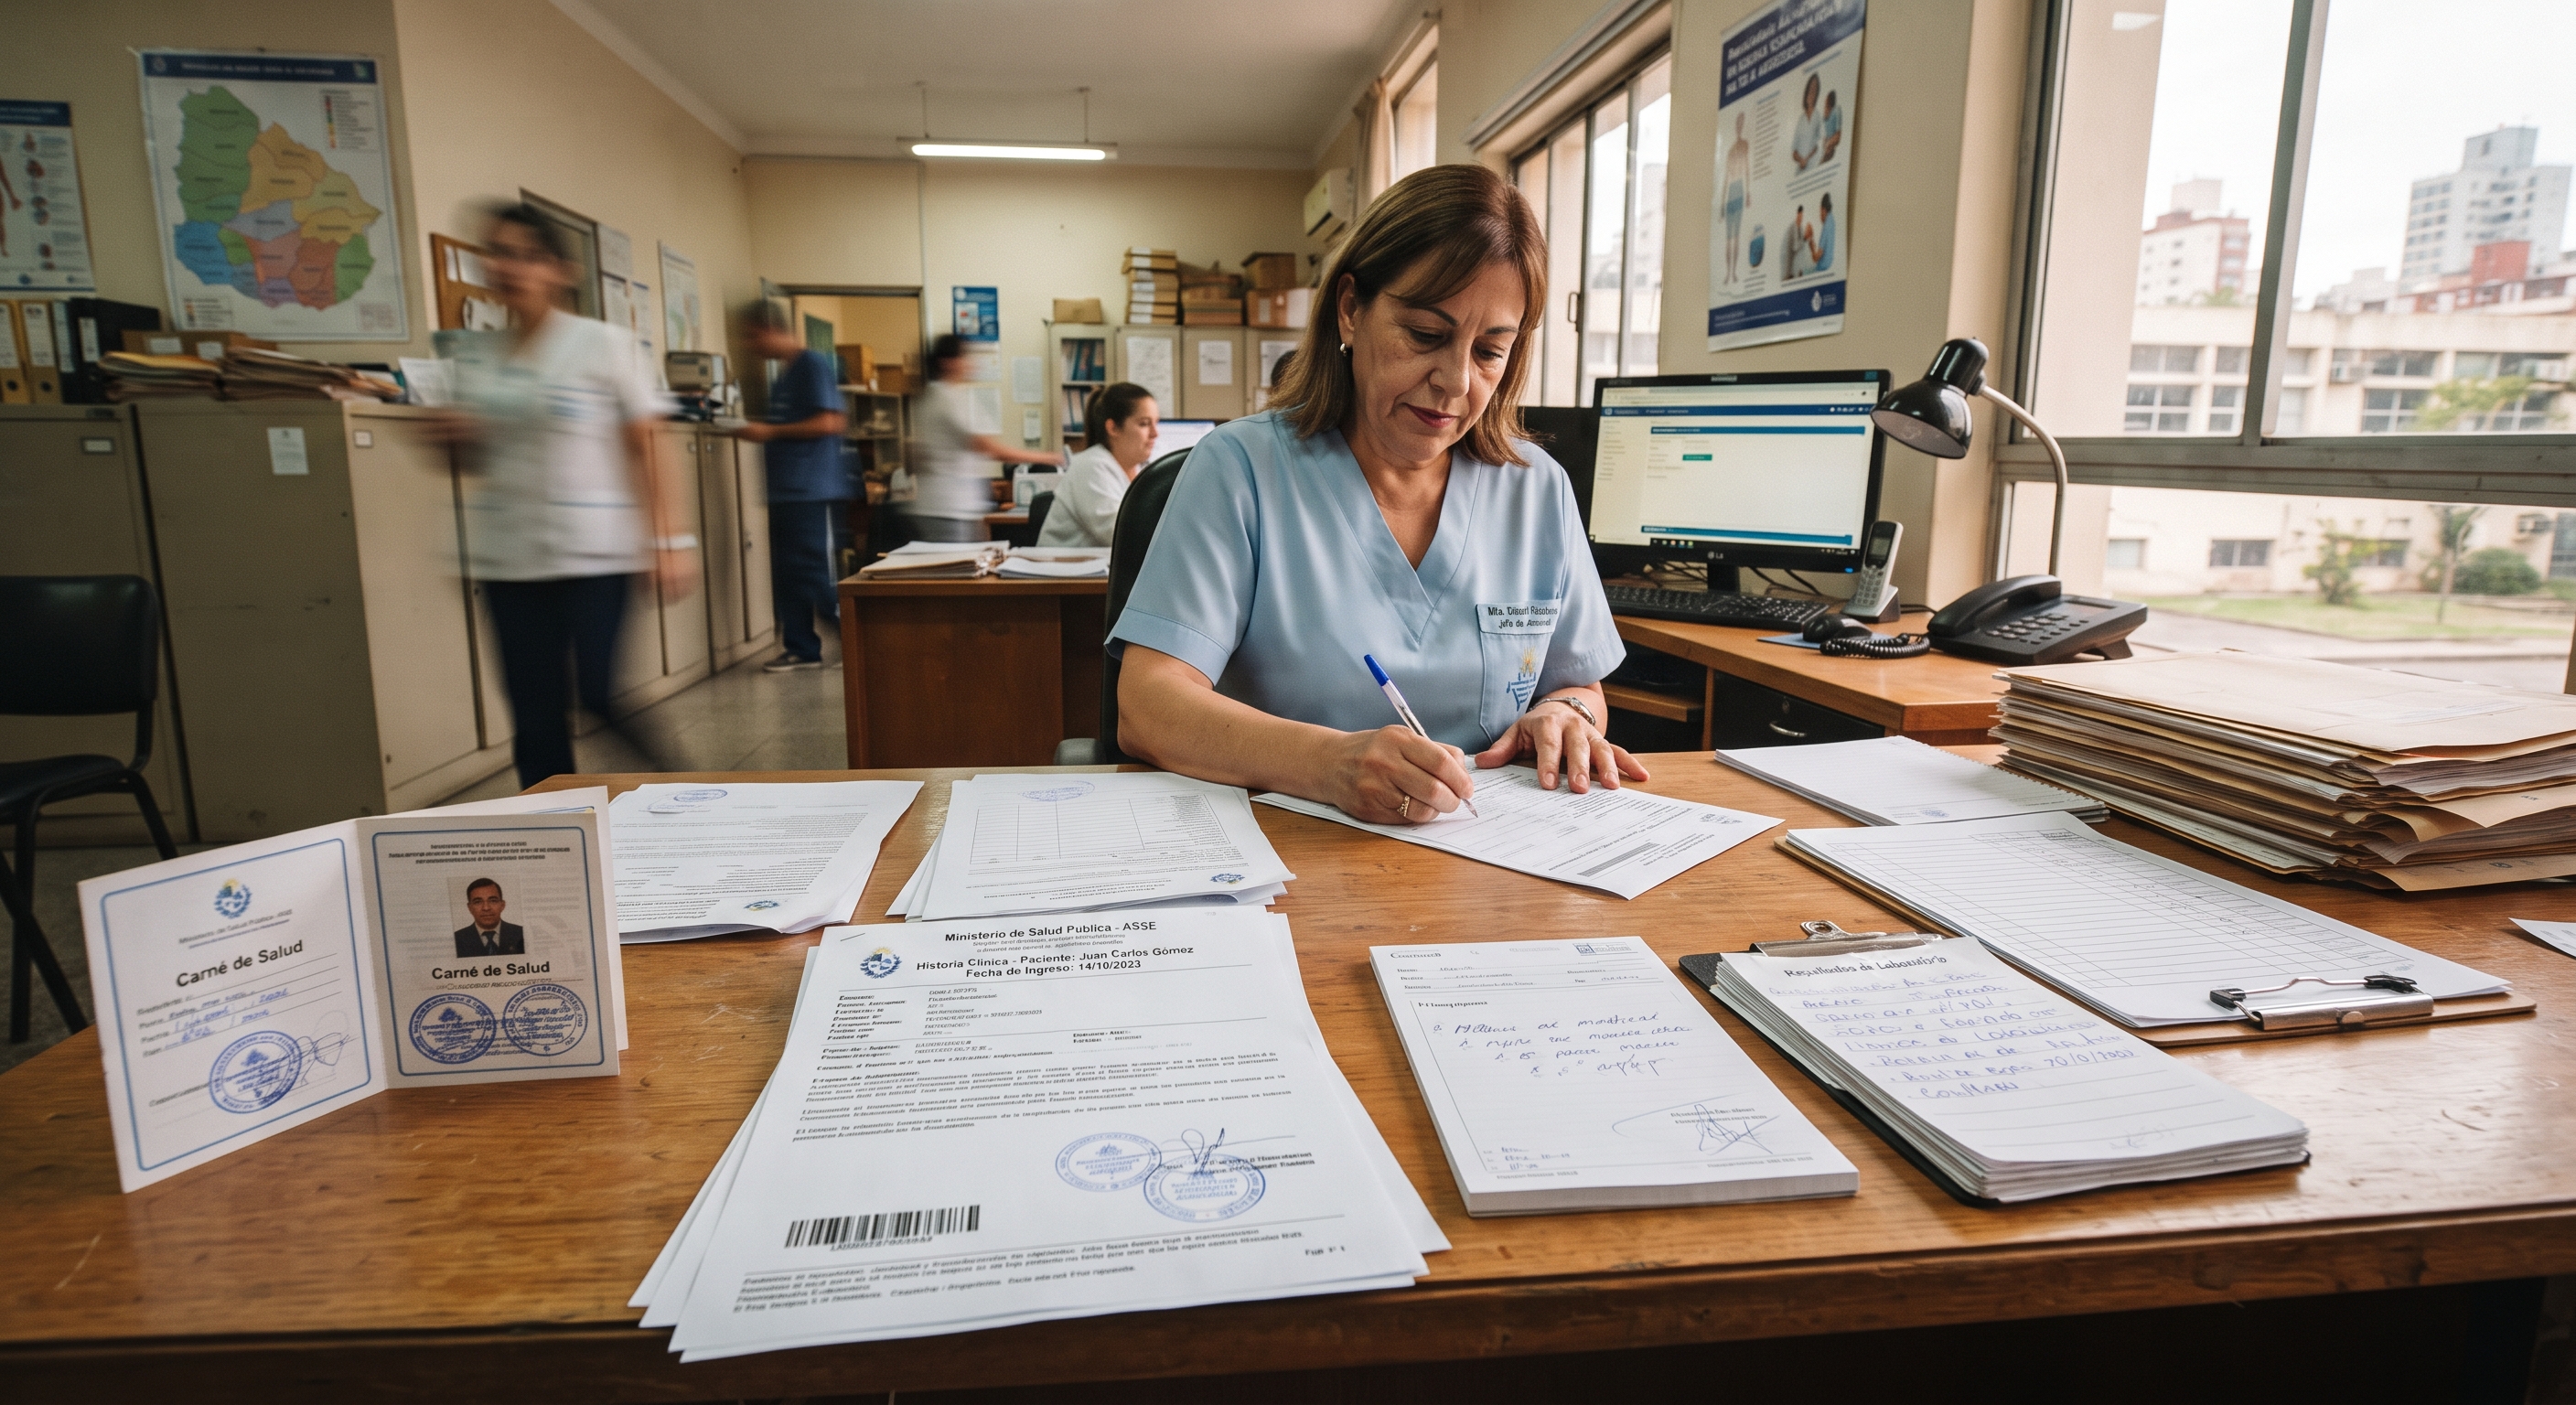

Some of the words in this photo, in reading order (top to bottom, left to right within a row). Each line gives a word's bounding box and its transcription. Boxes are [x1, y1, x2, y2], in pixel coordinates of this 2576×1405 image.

[945, 931, 1006, 941] Ministerio
[1009, 929, 1025, 938] de
[1029, 927, 1063, 937] Salud
[1122, 922, 1157, 931] ASSE
[176, 960, 228, 988] Carné
[232, 956, 253, 971] de
[258, 939, 304, 964] Salud
[917, 960, 964, 971] Historia
[1020, 954, 1076, 964] Paciente:
[1079, 952, 1108, 960] Juan
[1111, 949, 1149, 958] Carlos
[1153, 947, 1194, 956] Gómez
[1860, 962, 1874, 971] de
[431, 966, 478, 980] Carné
[483, 964, 502, 976] de
[506, 961, 551, 975] Salud
[966, 969, 1003, 978] Fecha
[1006, 967, 1022, 975] de
[1025, 965, 1074, 976] Ingreso:
[1079, 960, 1142, 971] 14/10/2023
